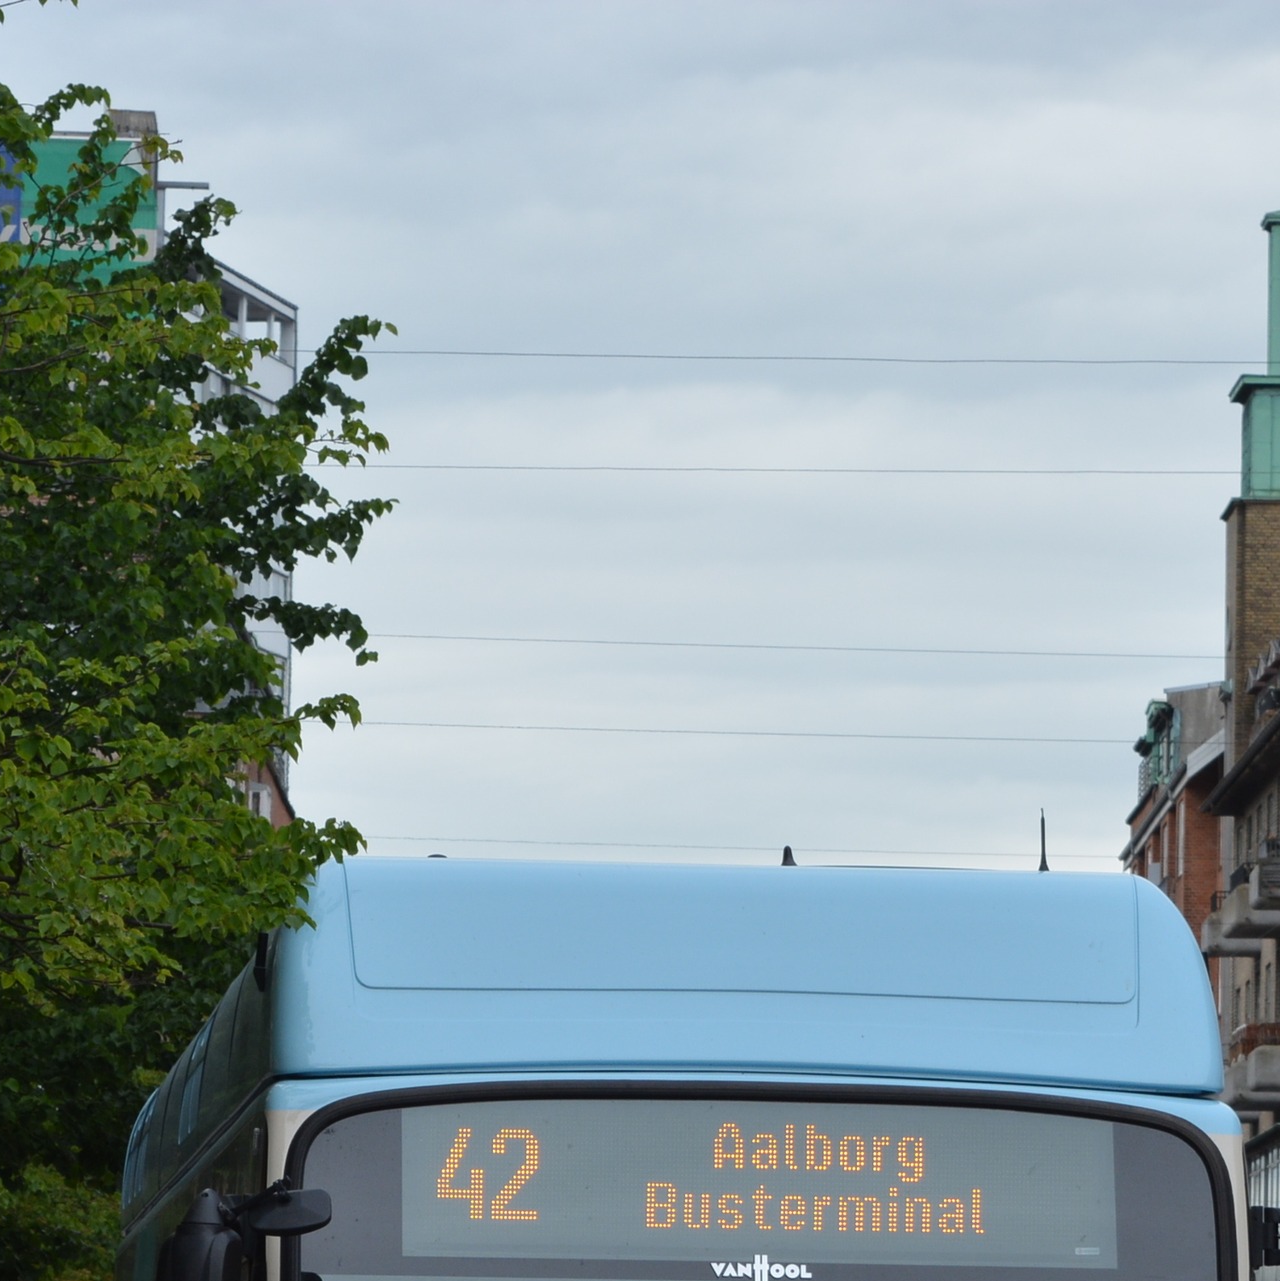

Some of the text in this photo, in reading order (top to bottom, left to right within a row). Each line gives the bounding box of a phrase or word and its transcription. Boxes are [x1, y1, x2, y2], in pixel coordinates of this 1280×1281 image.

[436, 1127, 539, 1220] 42
[713, 1122, 924, 1183] Aalborg
[646, 1181, 985, 1234] Busterminal
